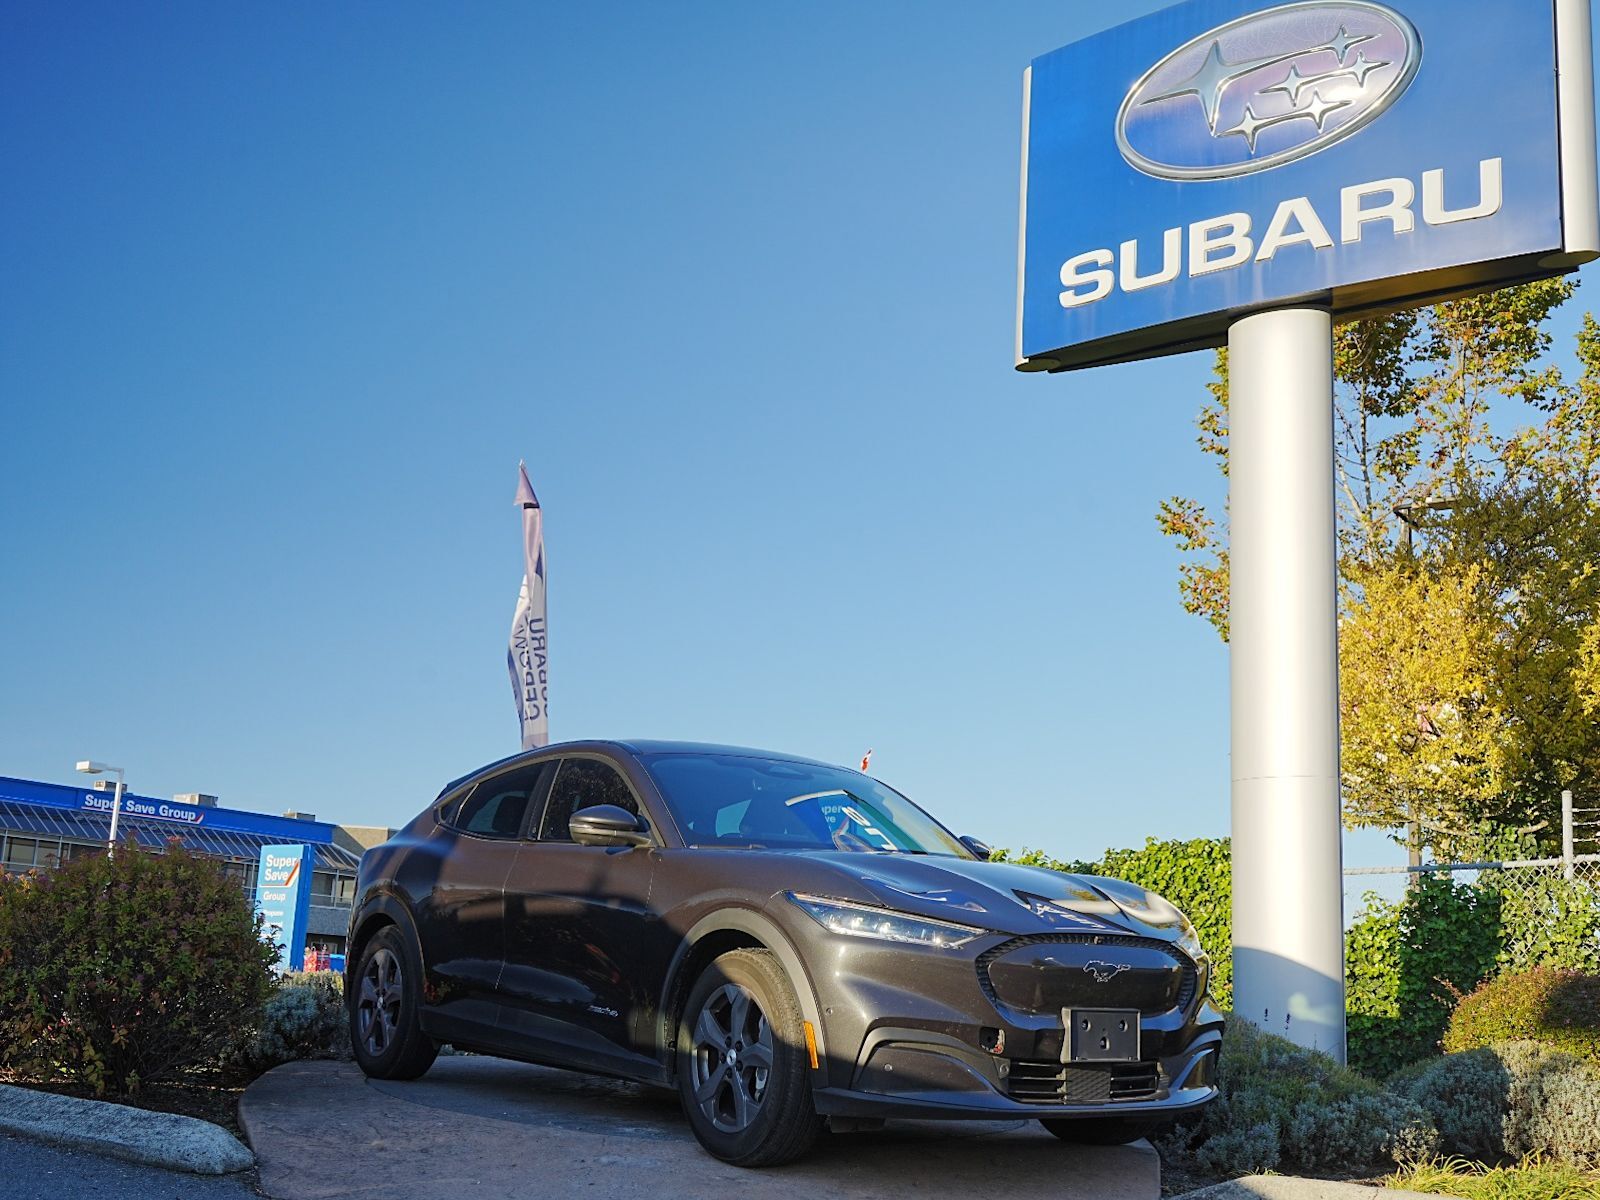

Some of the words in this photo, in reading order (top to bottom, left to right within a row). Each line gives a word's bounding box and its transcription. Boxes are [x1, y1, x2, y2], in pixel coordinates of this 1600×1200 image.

[1059, 157, 1502, 308] SUBARU
[84, 794, 122, 811] Supe
[126, 800, 155, 815] Save
[159, 805, 196, 821] Group
[265, 854, 297, 869] Super
[264, 869, 289, 881] Save
[263, 891, 286, 902] Group
